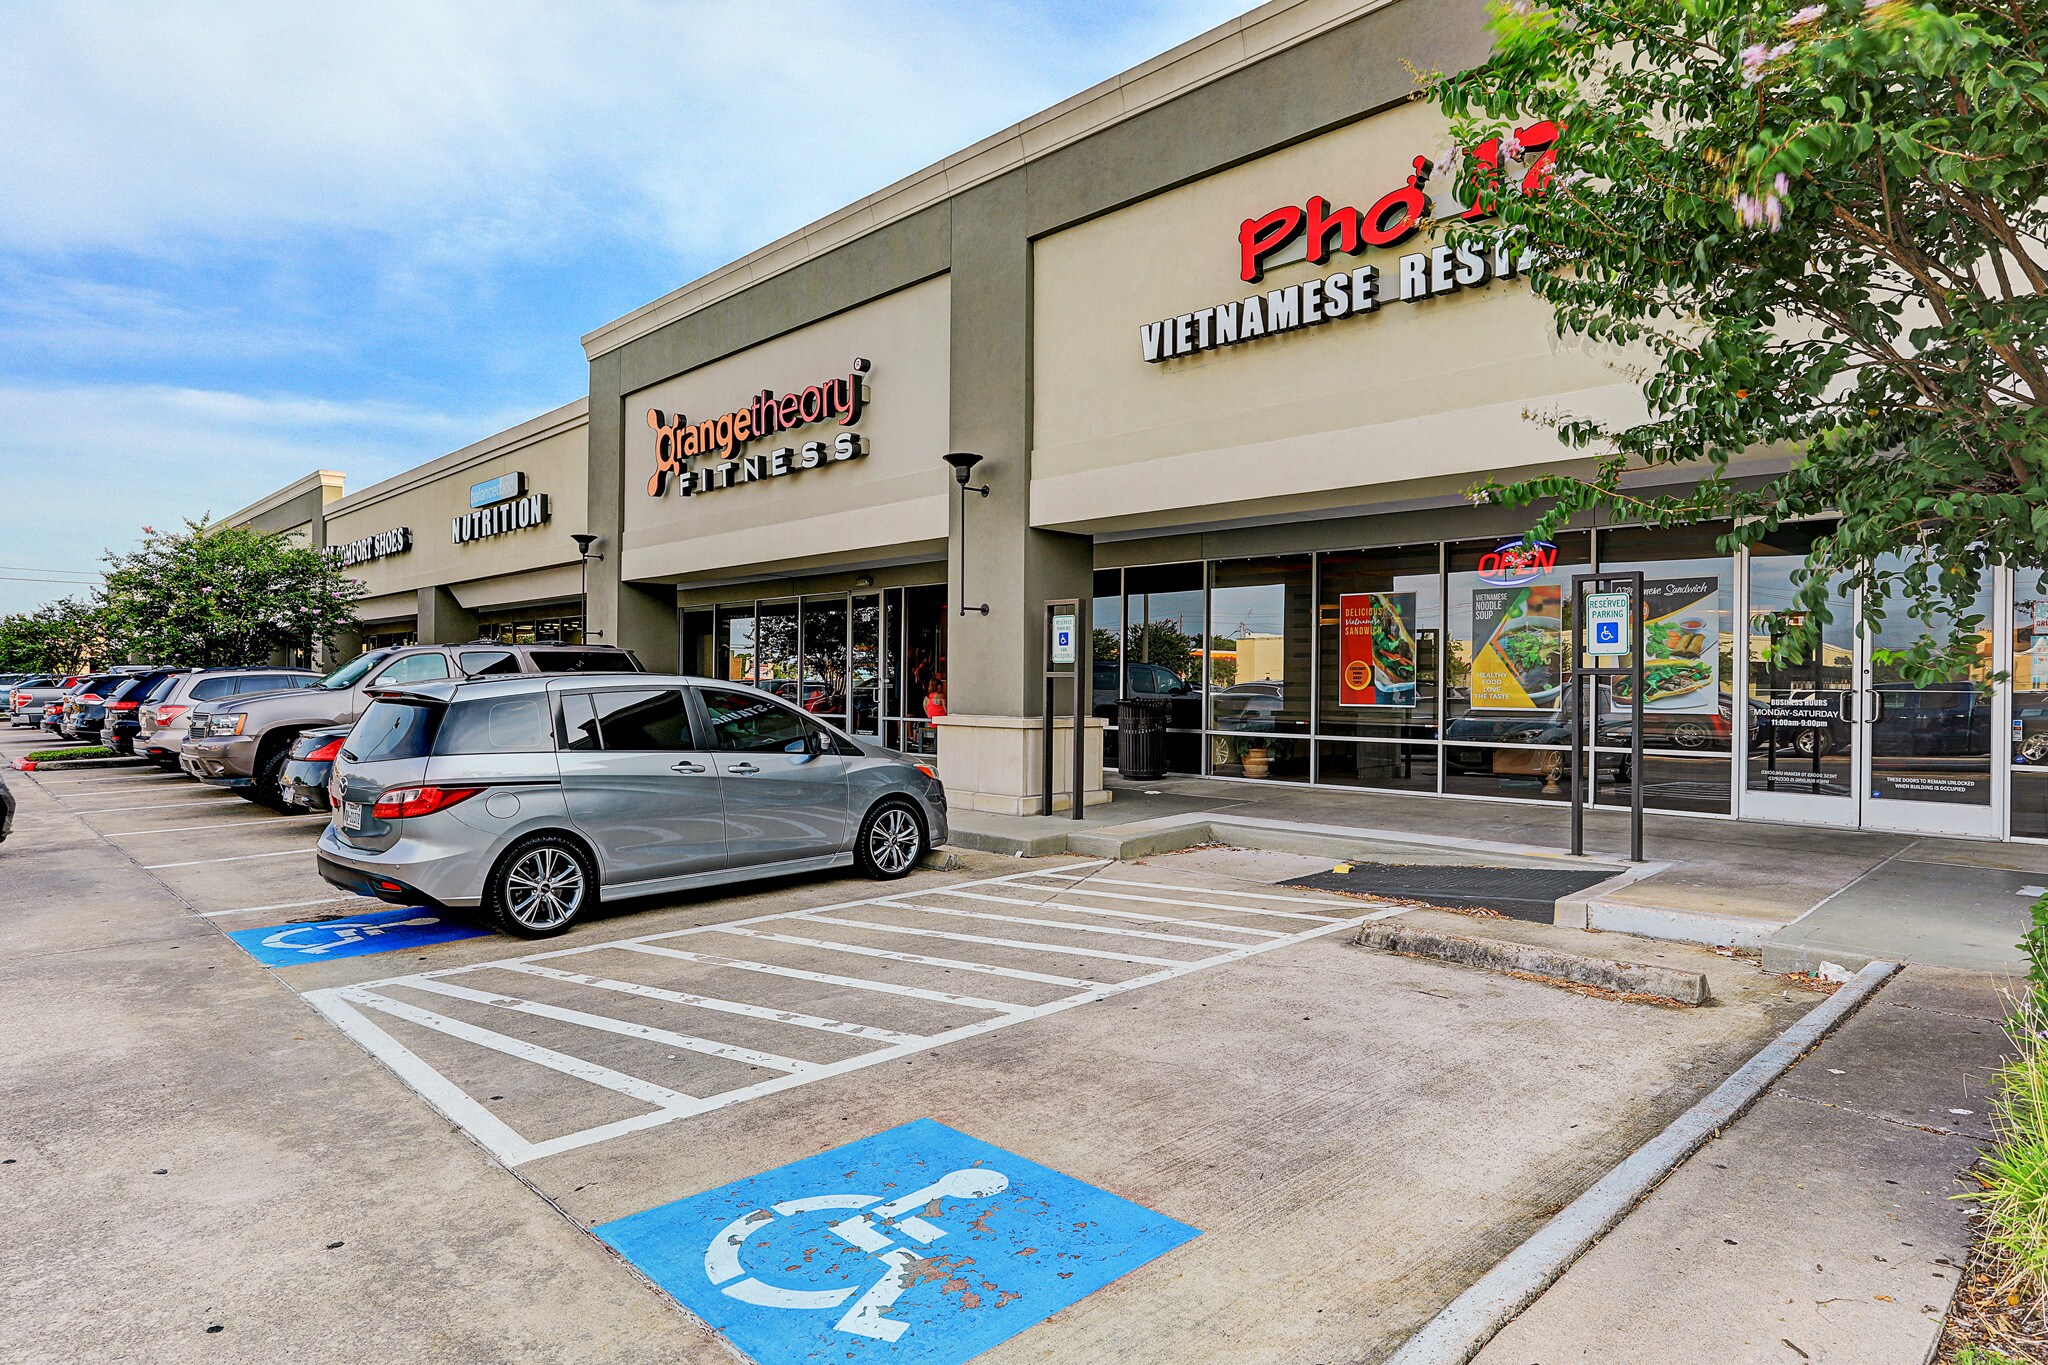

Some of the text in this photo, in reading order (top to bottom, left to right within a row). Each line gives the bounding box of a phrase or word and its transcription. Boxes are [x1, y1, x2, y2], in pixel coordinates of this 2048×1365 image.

[1462, 120, 1568, 219] 17
[1139, 264, 1375, 364] VIETNAMESE
[679, 432, 854, 497] FITNESS
[451, 494, 542, 544] NUTRITION
[375, 527, 404, 557] SHOES
[1477, 547, 1558, 578] OPEN
[1664, 582, 1708, 596] Sandwich
[1475, 593, 1508, 601] VIETNAMESE
[1475, 601, 1502, 611] NOODLE
[1589, 599, 1626, 609] RESERVED
[1345, 607, 1382, 617] DELICIOUS
[1475, 611, 1494, 620] SOUP
[1592, 610, 1624, 619] PARKING
[1345, 626, 1383, 636] SANDWICH
[1804, 699, 1828, 707] HOURS
[1753, 708, 1839, 718] MONDAY-SATURDAY
[1771, 719, 1828, 728] 11:00am-9:00pm
